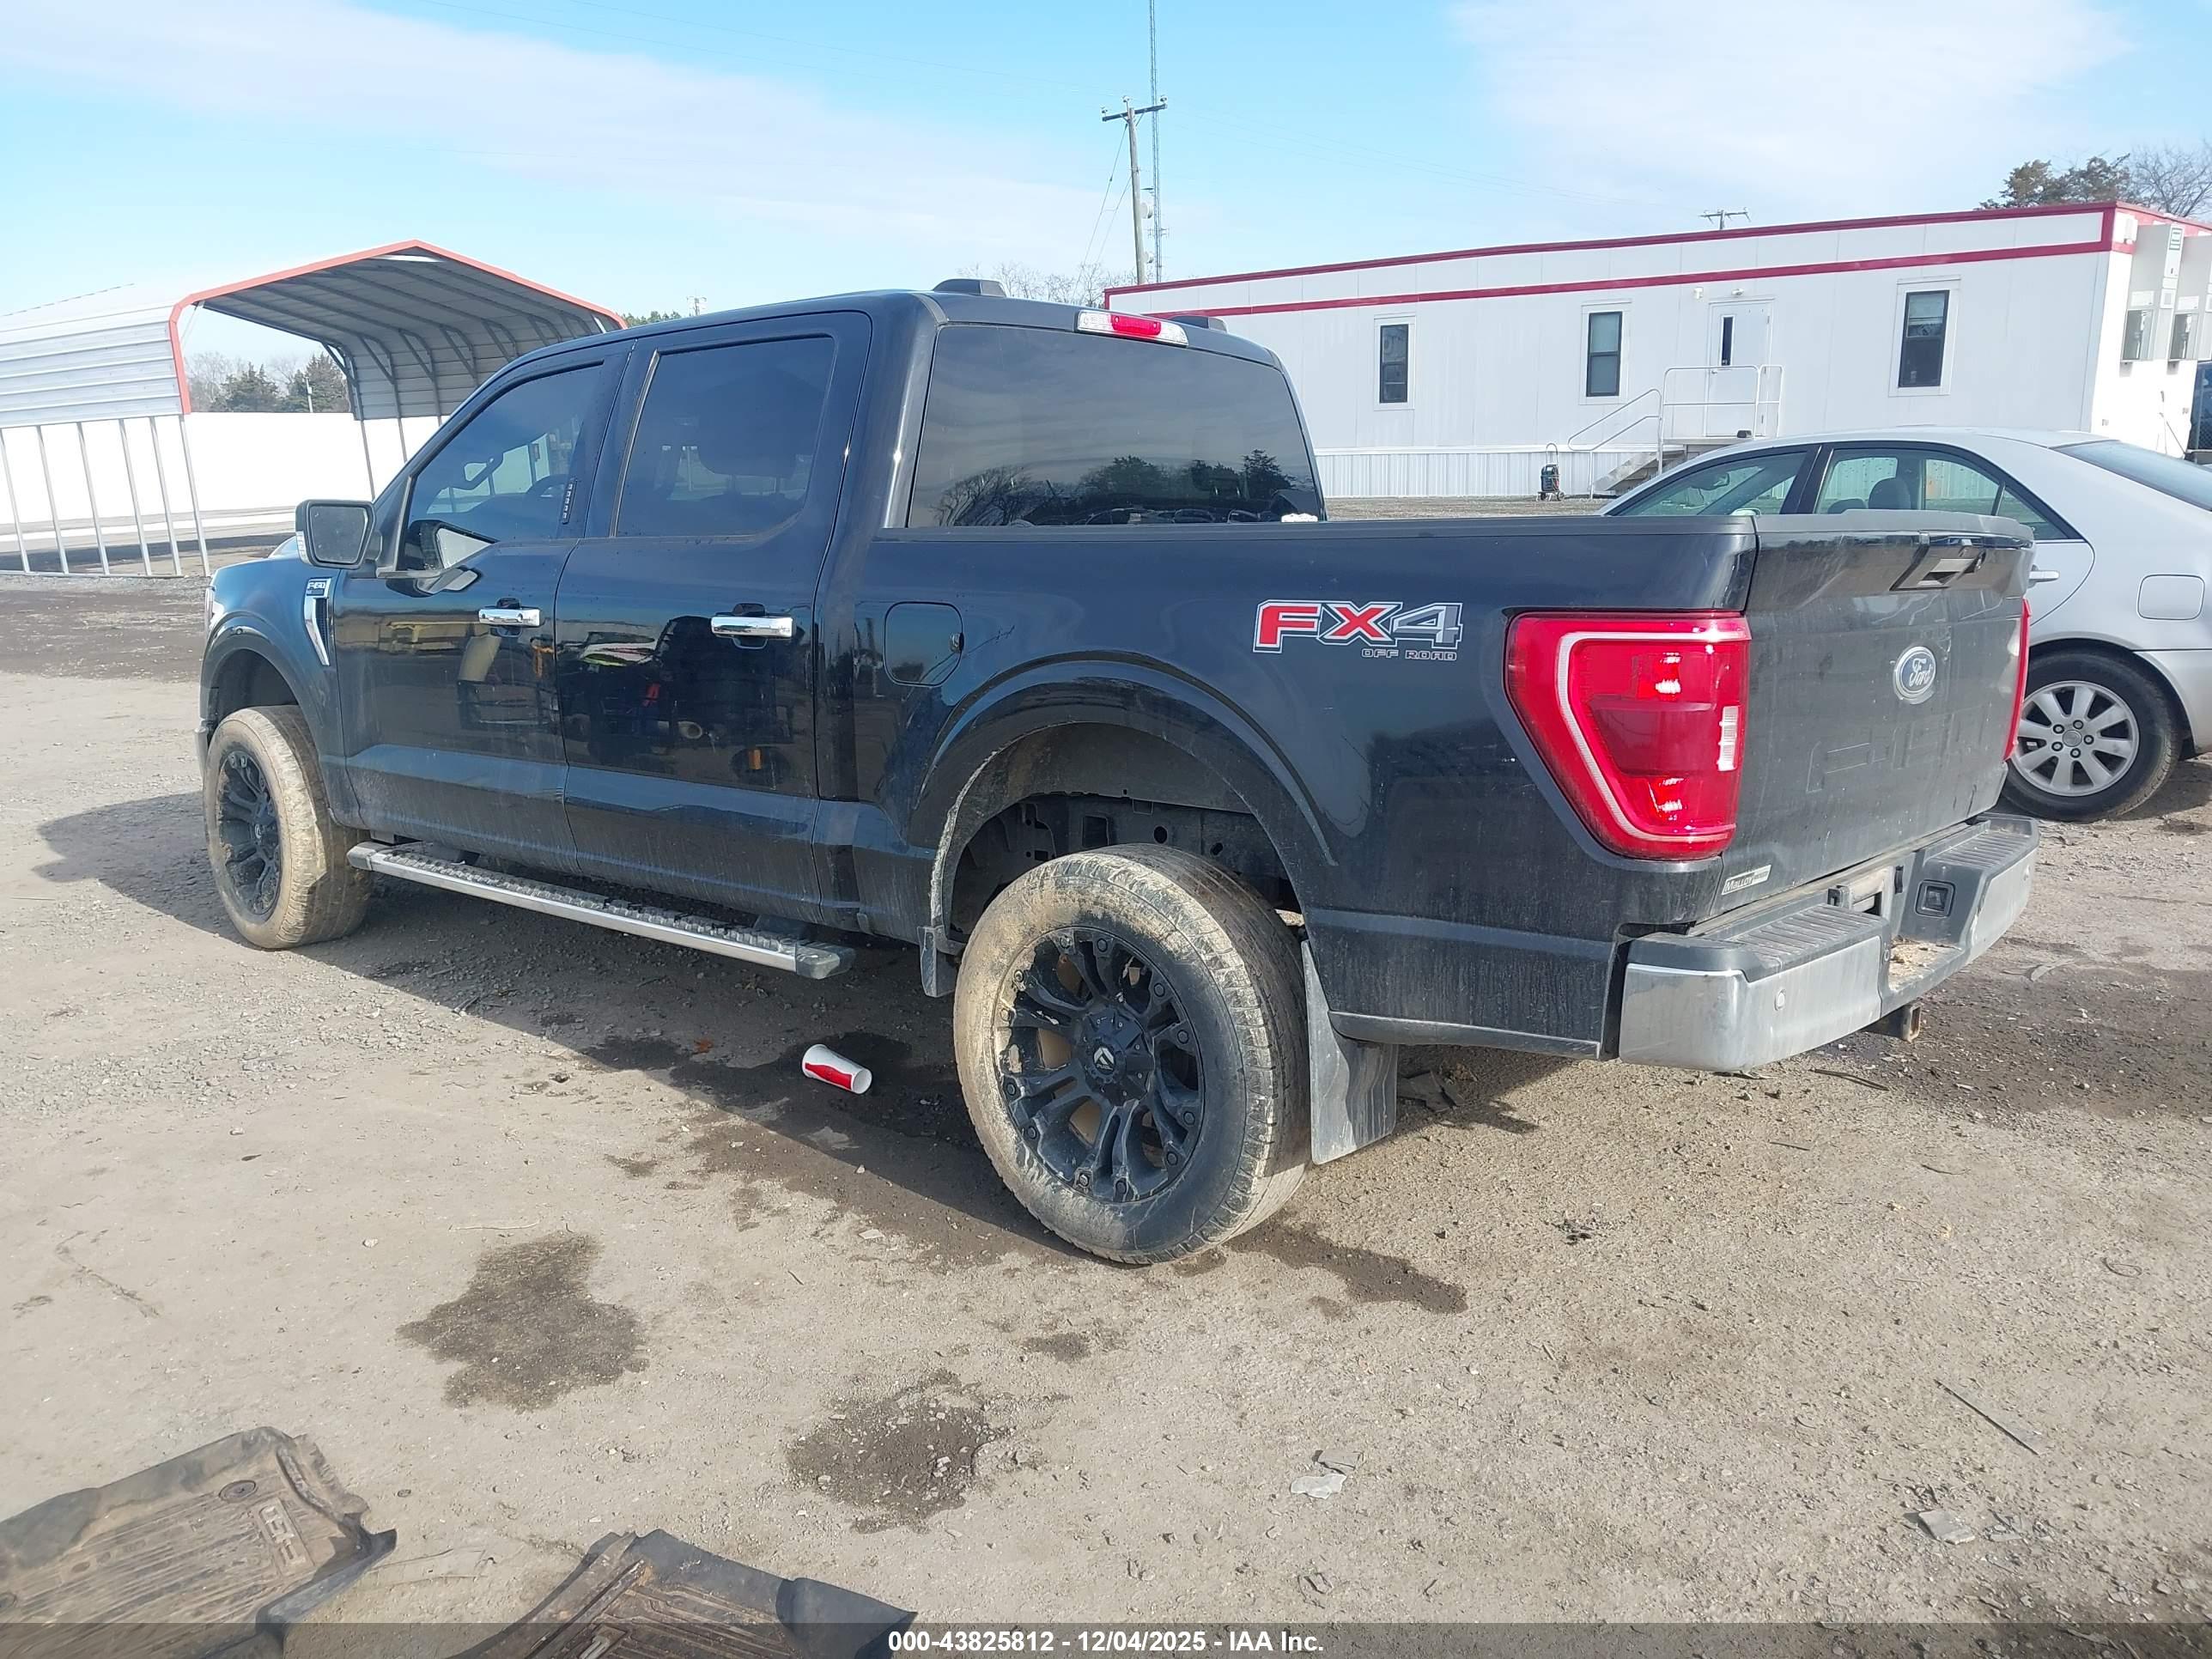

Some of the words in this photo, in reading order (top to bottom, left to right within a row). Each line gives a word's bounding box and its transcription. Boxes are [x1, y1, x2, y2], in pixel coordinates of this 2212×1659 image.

[1253, 599, 1463, 653] FX4
[1361, 648, 1400, 659] OFF
[1405, 650, 1457, 661] ROAD
[1909, 658, 1933, 687] Ford
